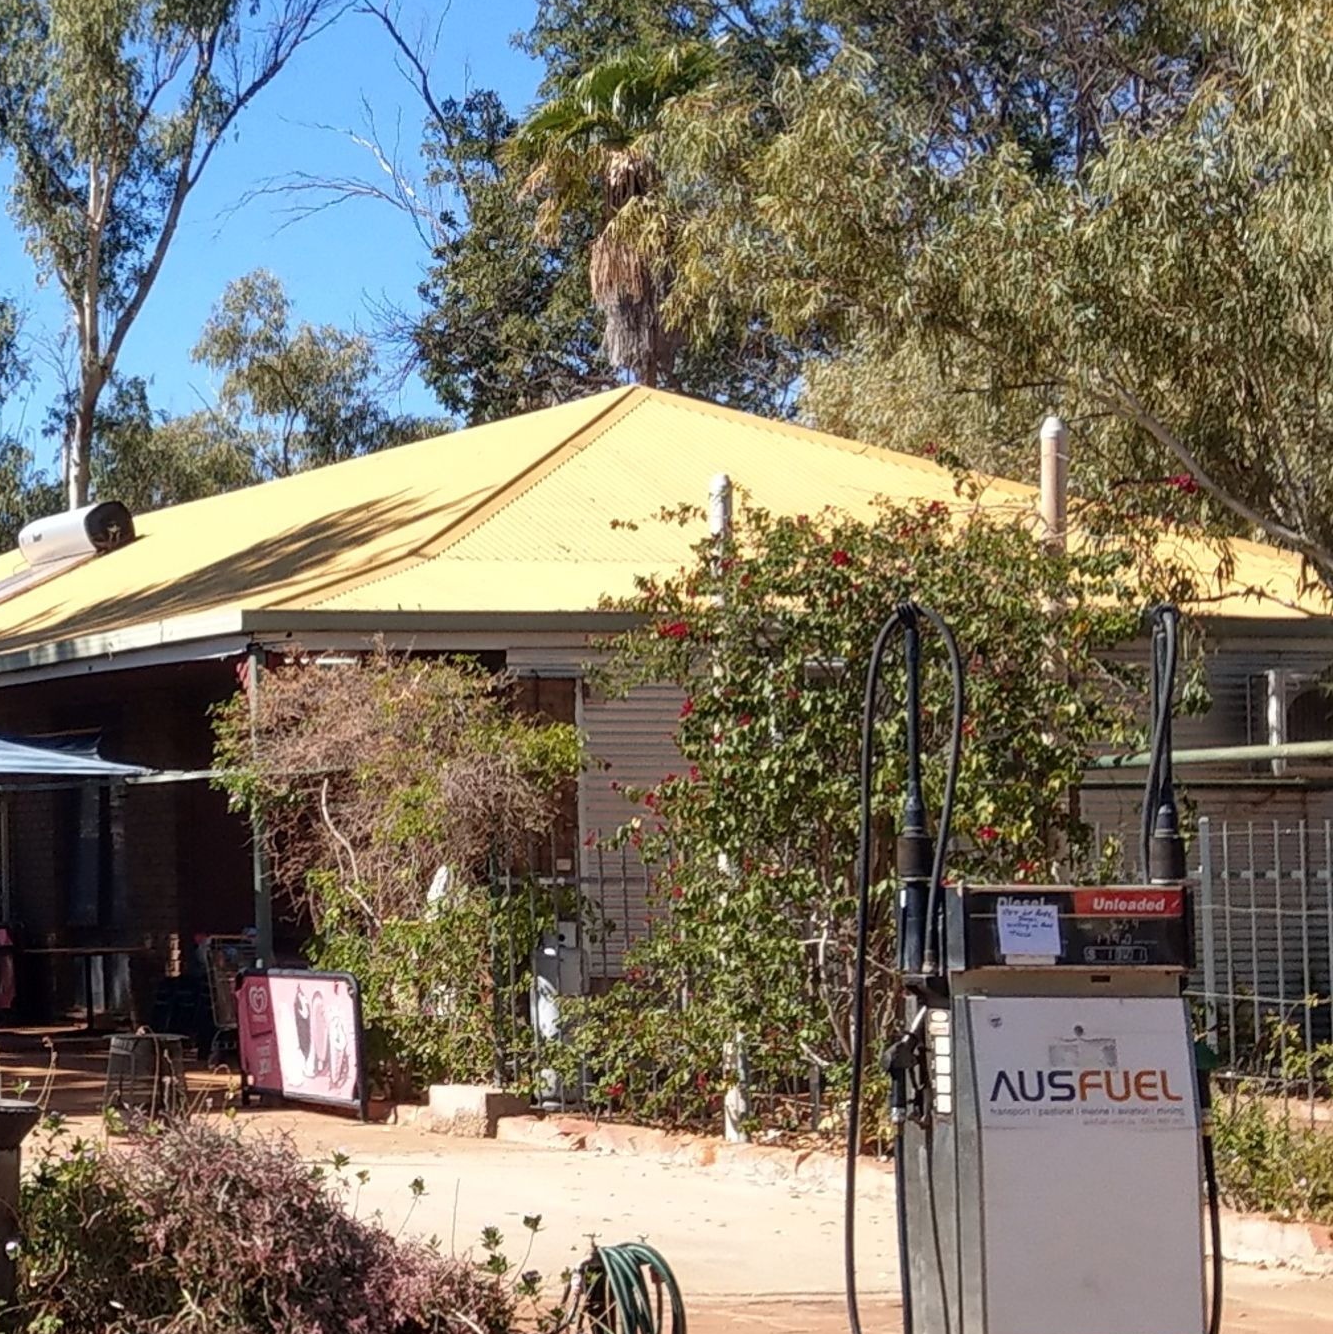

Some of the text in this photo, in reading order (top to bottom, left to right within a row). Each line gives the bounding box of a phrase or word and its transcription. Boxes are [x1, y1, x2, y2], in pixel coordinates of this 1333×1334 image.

[1092, 897, 1165, 911] Unleaded
[989, 1069, 1183, 1102] AUSFUEL
[990, 1106, 1031, 1117] transport
